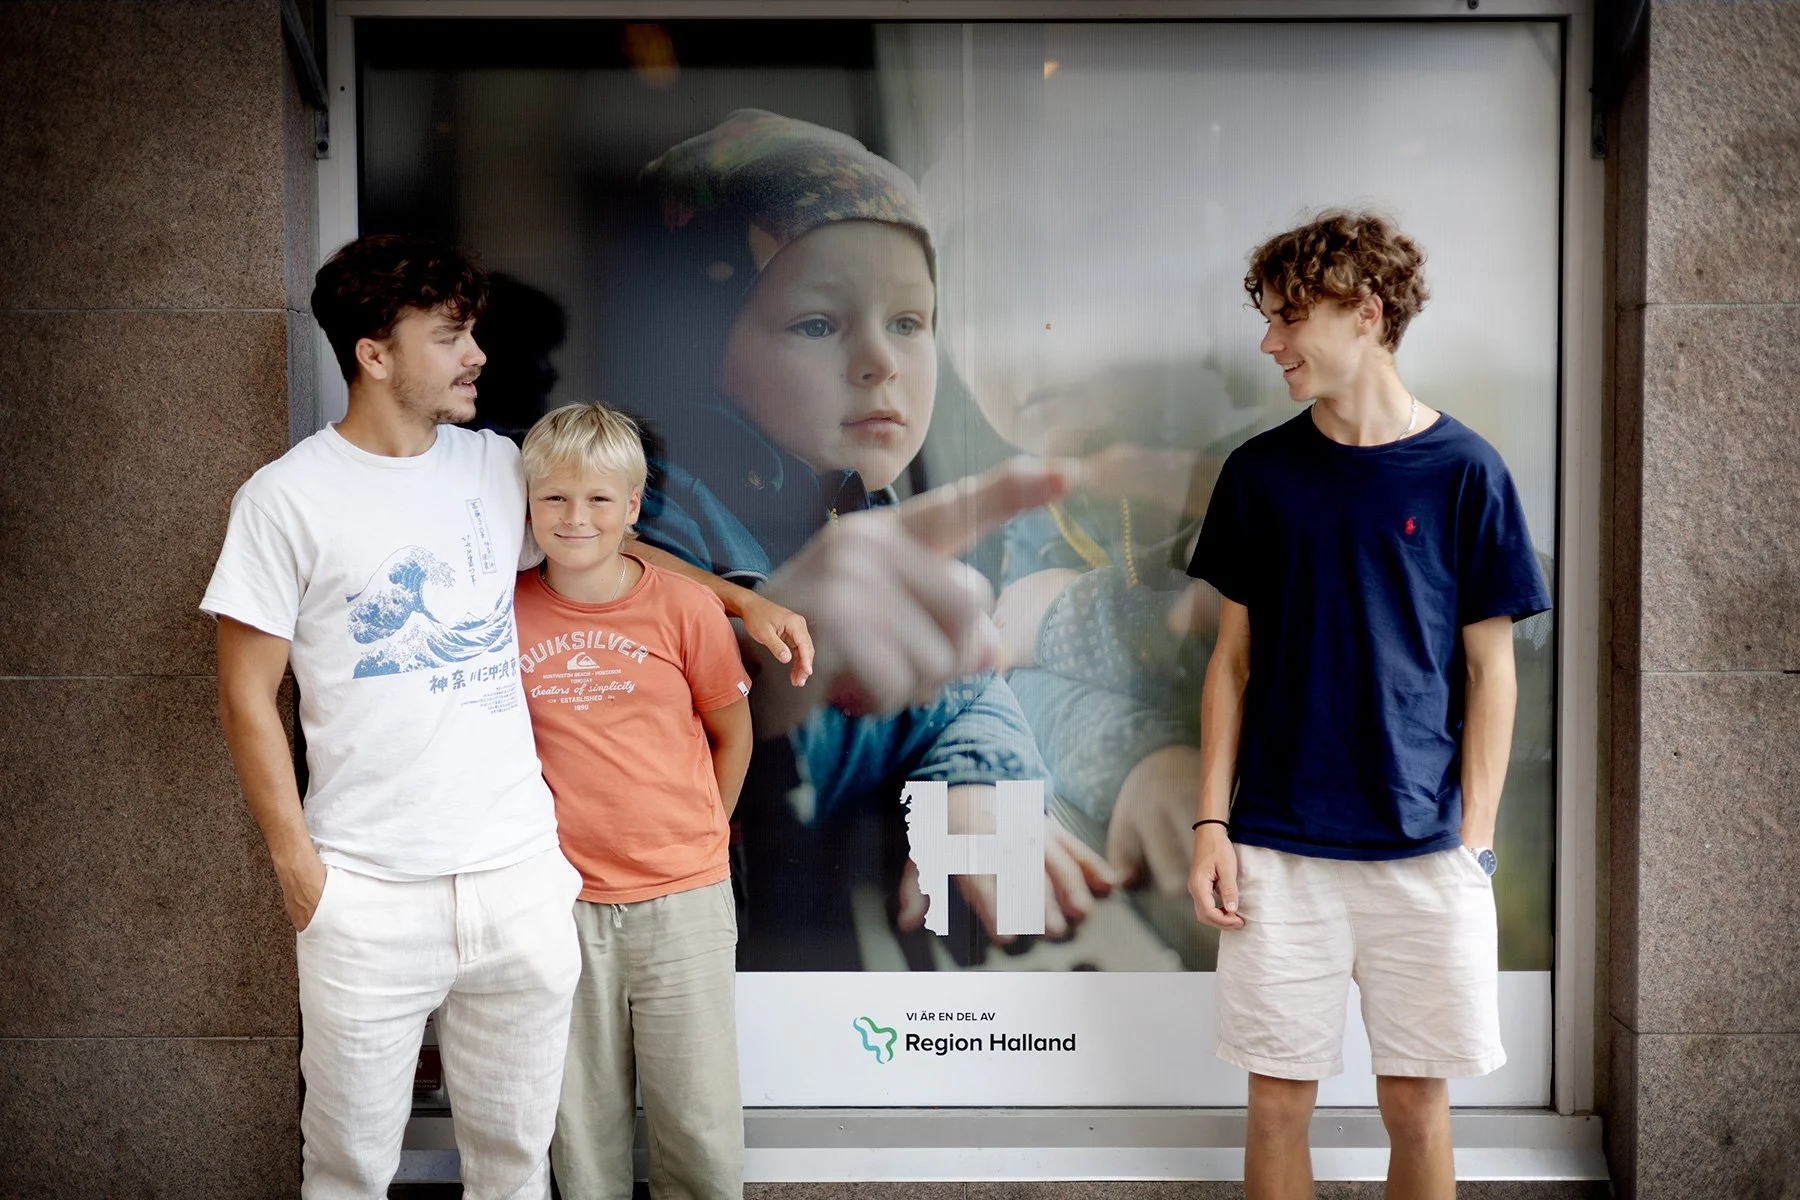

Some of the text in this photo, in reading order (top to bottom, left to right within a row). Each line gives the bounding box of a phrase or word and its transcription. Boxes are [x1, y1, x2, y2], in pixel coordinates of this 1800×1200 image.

[519, 630, 650, 674] QUIKSILVER
[530, 684, 569, 698] Creators
[574, 683, 587, 696] of
[588, 680, 636, 694] simplicity
[560, 695, 603, 704] ESTABLISHED
[899, 780, 1046, 936] H
[906, 1010, 996, 1021] VI ÄR EN DEL AV
[906, 1033, 1076, 1056] Region Halland
